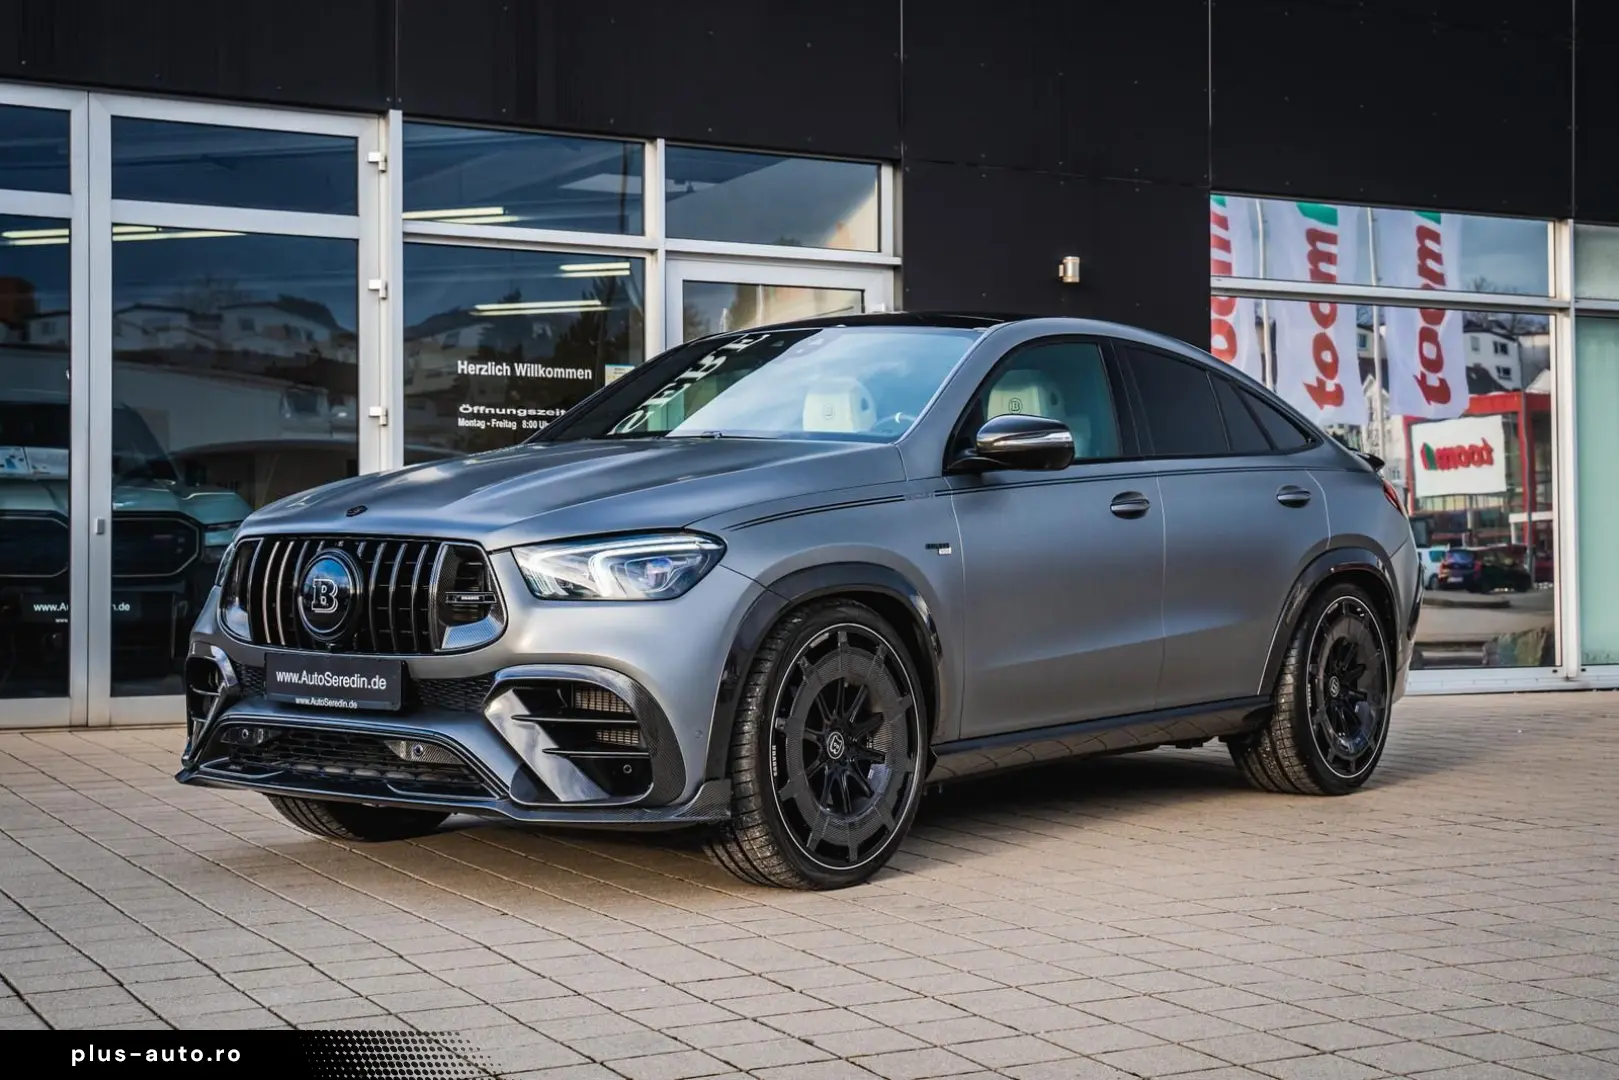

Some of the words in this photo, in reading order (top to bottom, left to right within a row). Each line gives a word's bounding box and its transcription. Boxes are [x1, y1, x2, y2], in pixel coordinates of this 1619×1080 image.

[1304, 227, 1345, 410] toom
[1414, 225, 1451, 405] toom
[457, 360, 511, 377] Herzlich
[514, 362, 592, 380] Willkommen
[458, 417, 486, 430] Montag
[491, 418, 517, 430] Freitag
[522, 419, 538, 429] 8:00
[312, 578, 338, 613] B
[276, 670, 387, 690] www.AutoSeredin.de
[295, 697, 358, 709] www.AutoSeredin.de
